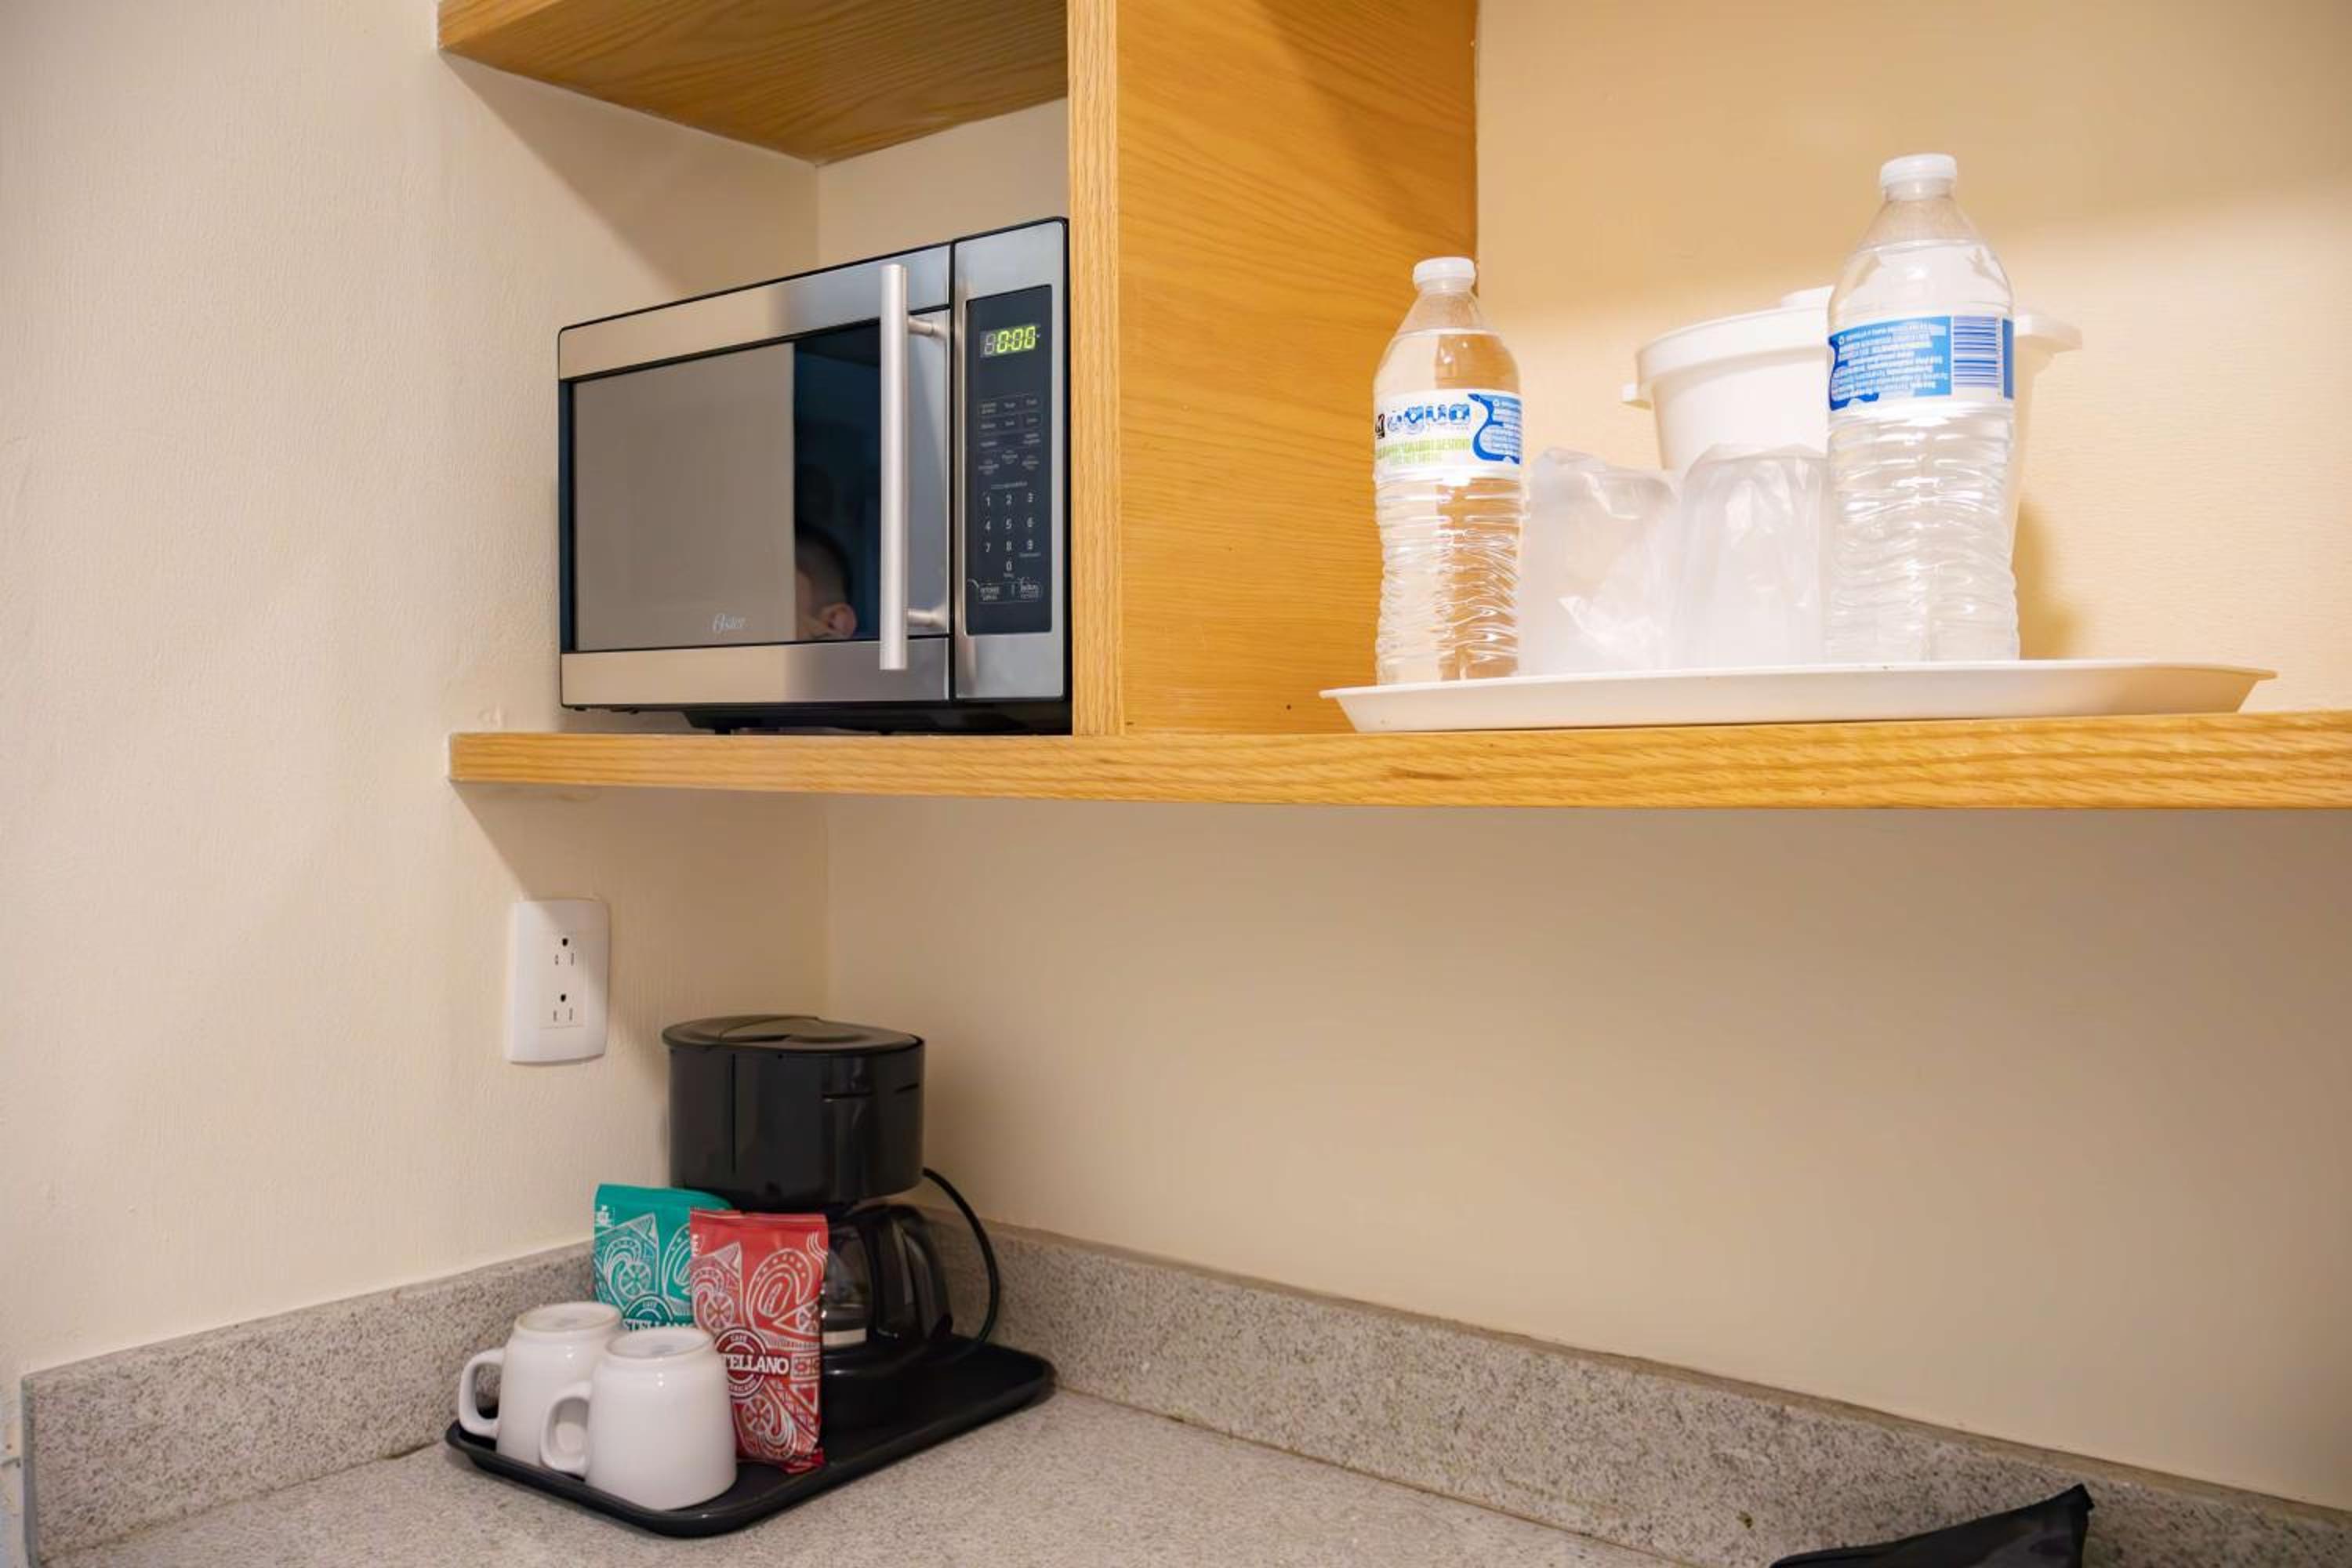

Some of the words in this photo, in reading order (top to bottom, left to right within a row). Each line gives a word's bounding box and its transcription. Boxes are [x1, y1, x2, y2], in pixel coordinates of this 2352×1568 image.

[985, 495, 991, 506] 1
[1005, 494, 1013, 506] 2
[985, 520, 991, 531] 4
[1005, 518, 1013, 530] 5
[985, 542, 991, 553] 7
[1005, 541, 1013, 551] 8
[1005, 561, 1013, 572] 0
